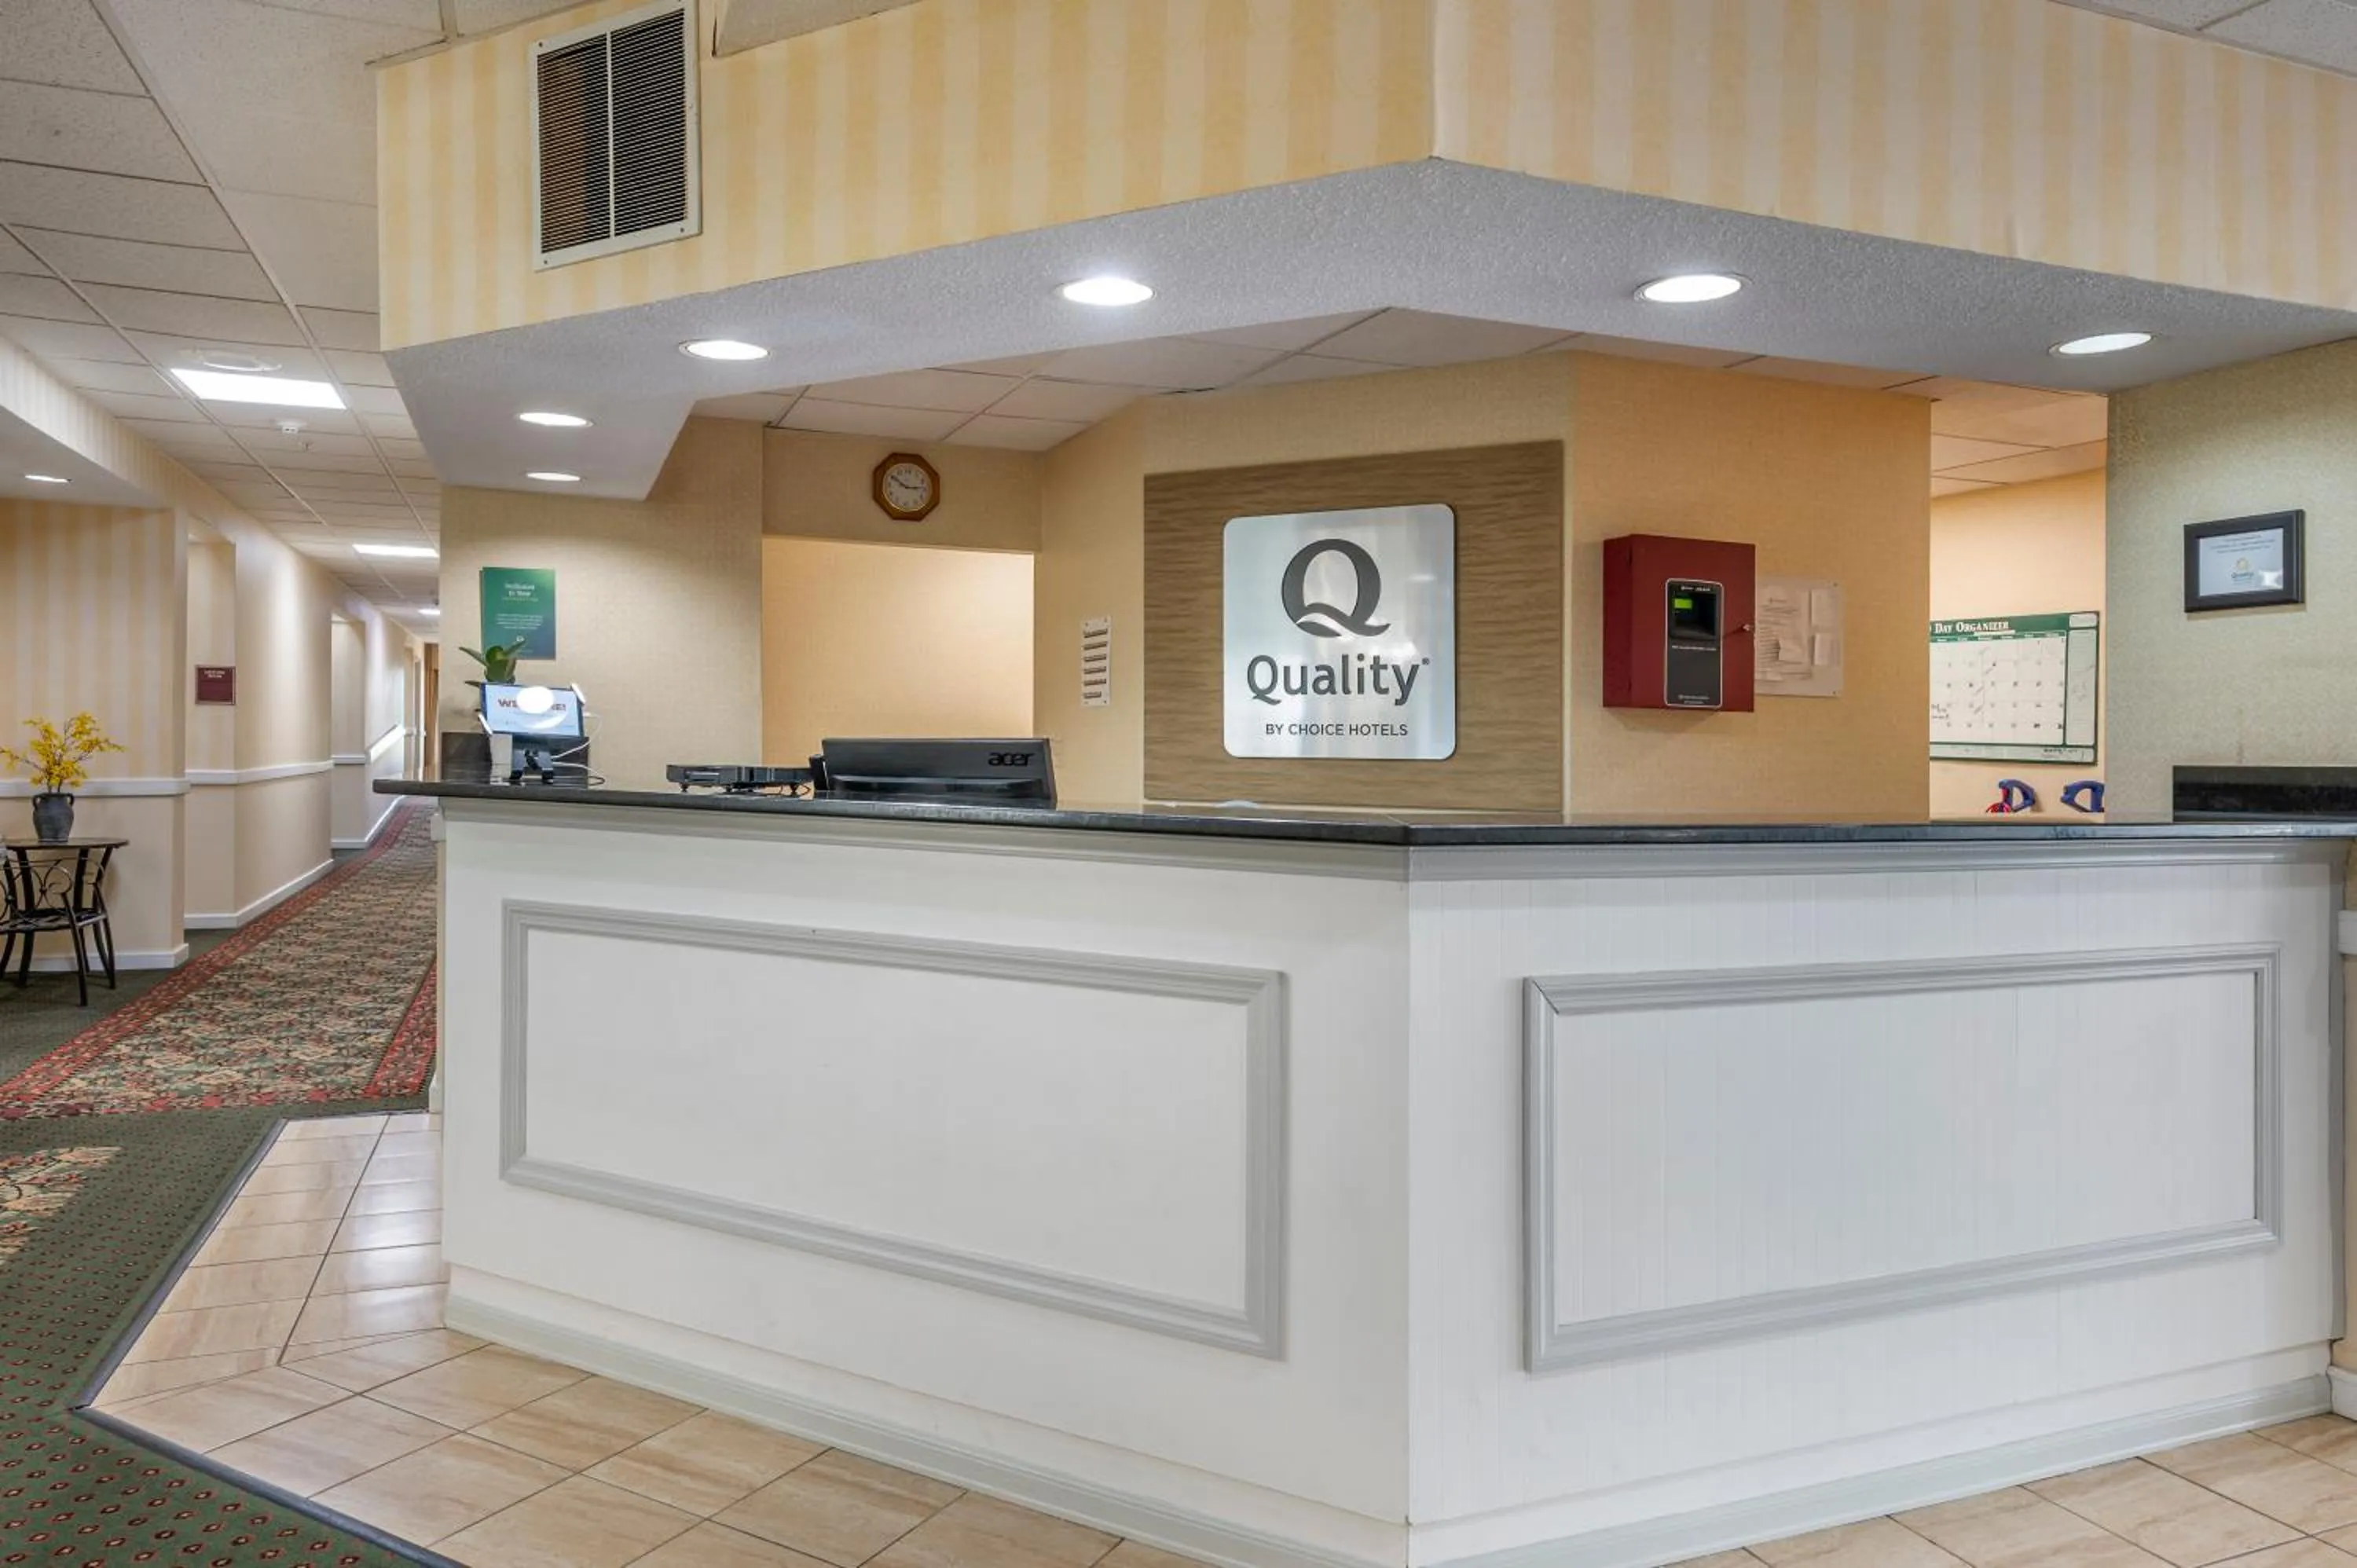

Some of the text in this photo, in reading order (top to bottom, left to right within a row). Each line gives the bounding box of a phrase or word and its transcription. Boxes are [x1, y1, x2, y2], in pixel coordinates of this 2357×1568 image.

[1956, 621, 2009, 632] ORGANIZER
[1247, 653, 1420, 705] Quality
[1266, 724, 1409, 736] BY CHOICE HOTELS
[988, 752, 1036, 767] acer
